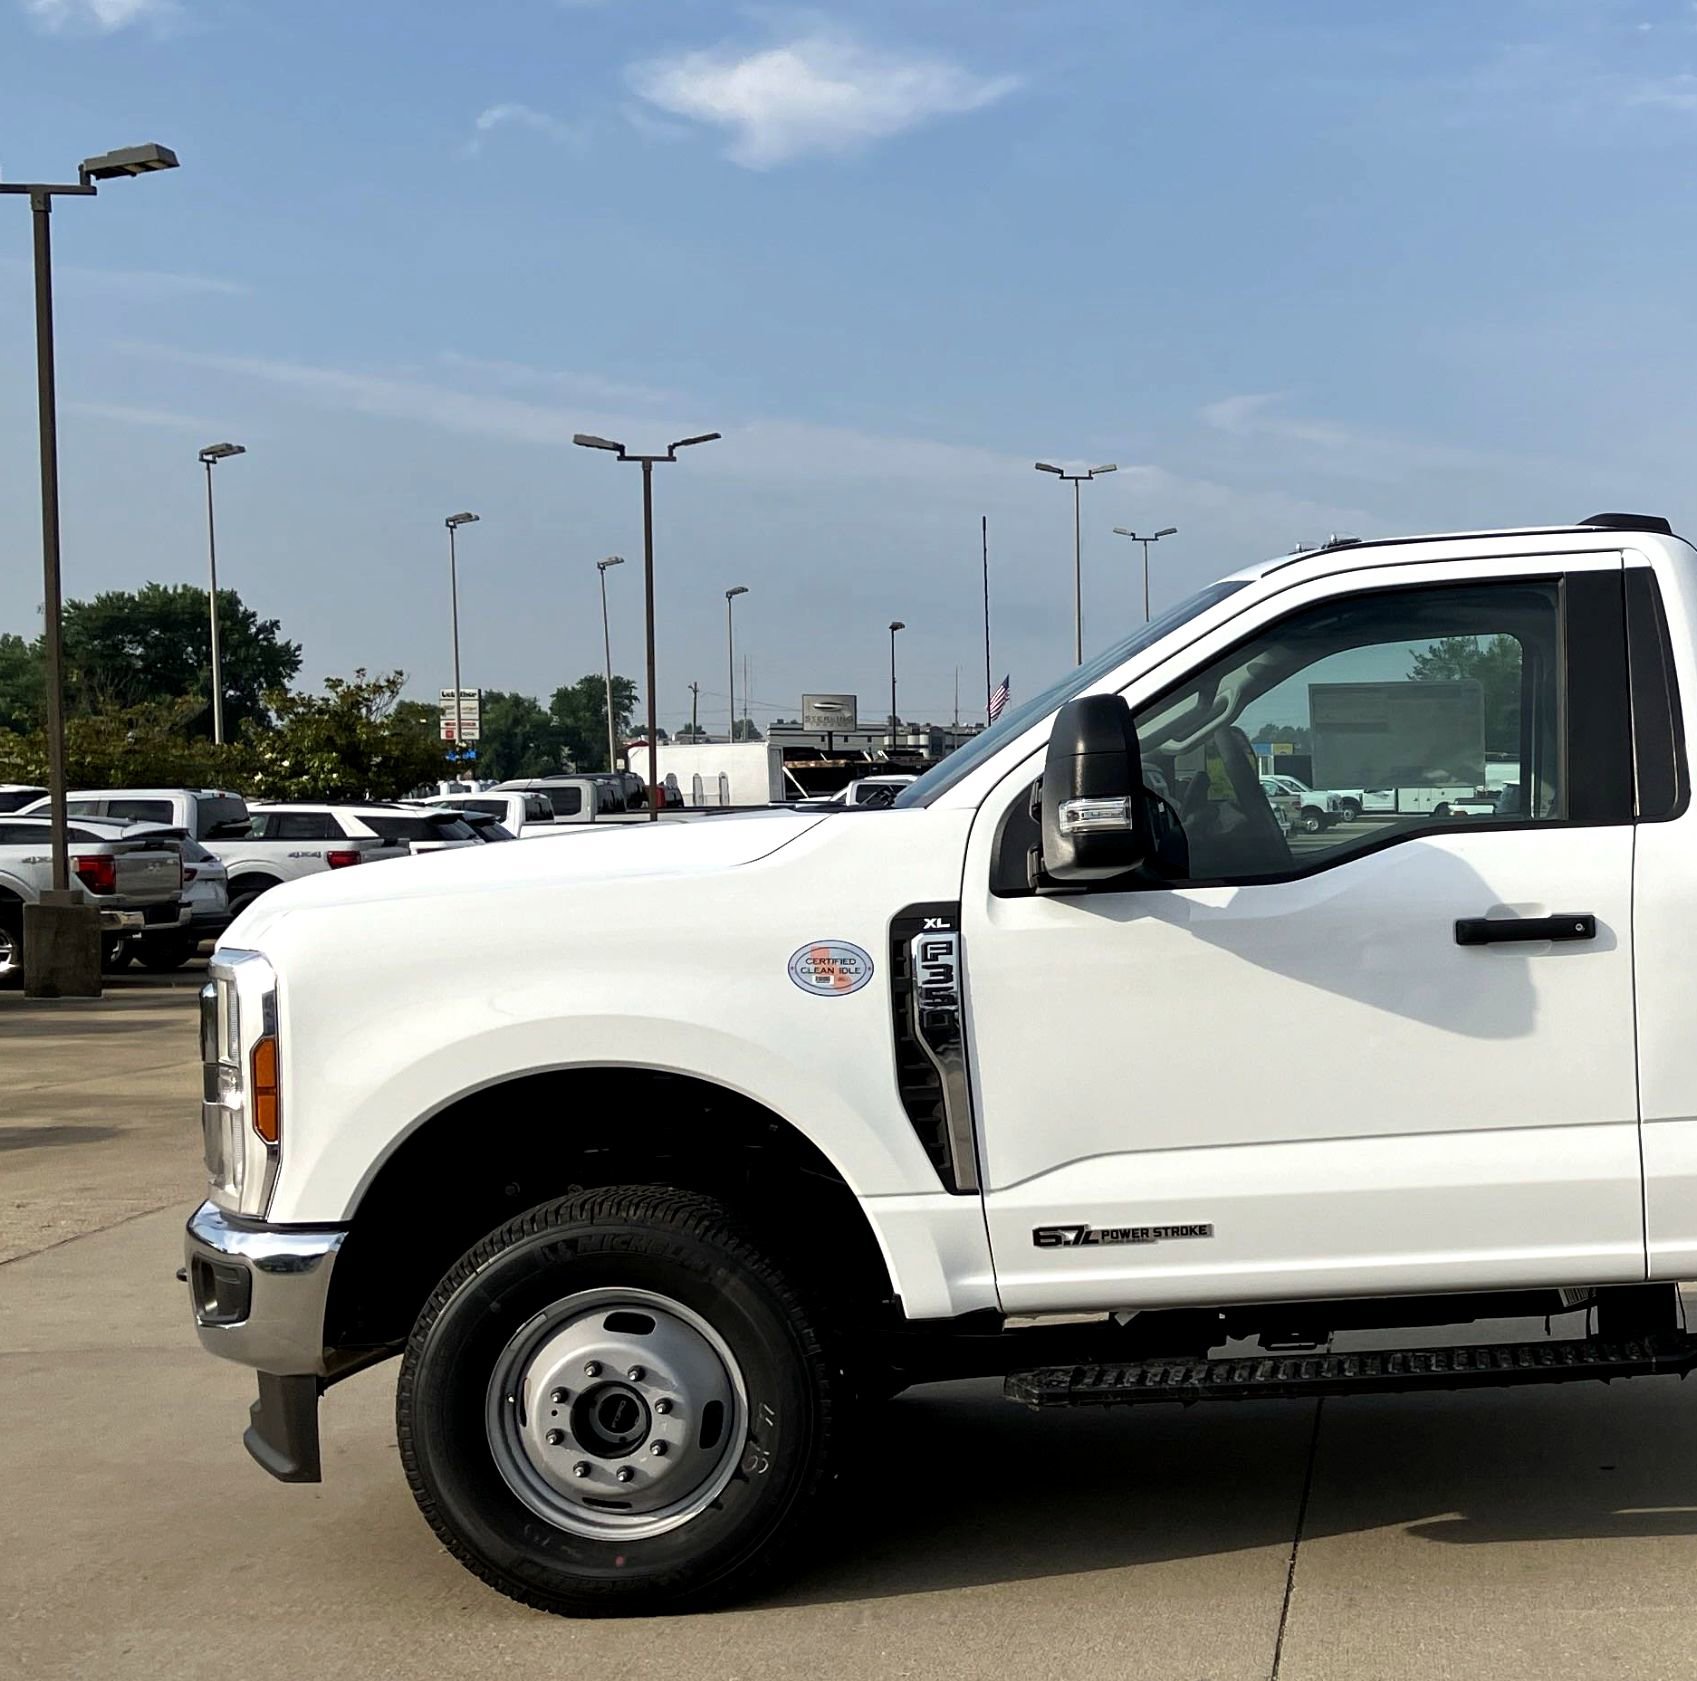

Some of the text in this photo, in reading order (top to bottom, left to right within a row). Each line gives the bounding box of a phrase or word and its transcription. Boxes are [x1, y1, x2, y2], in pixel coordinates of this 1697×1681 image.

[923, 918, 950, 929] XL
[805, 957, 857, 966] CERTIFIED
[800, 966, 861, 975] CLEAN IDLE
[1032, 1224, 1208, 1247] 6.7L POWER STROKE
